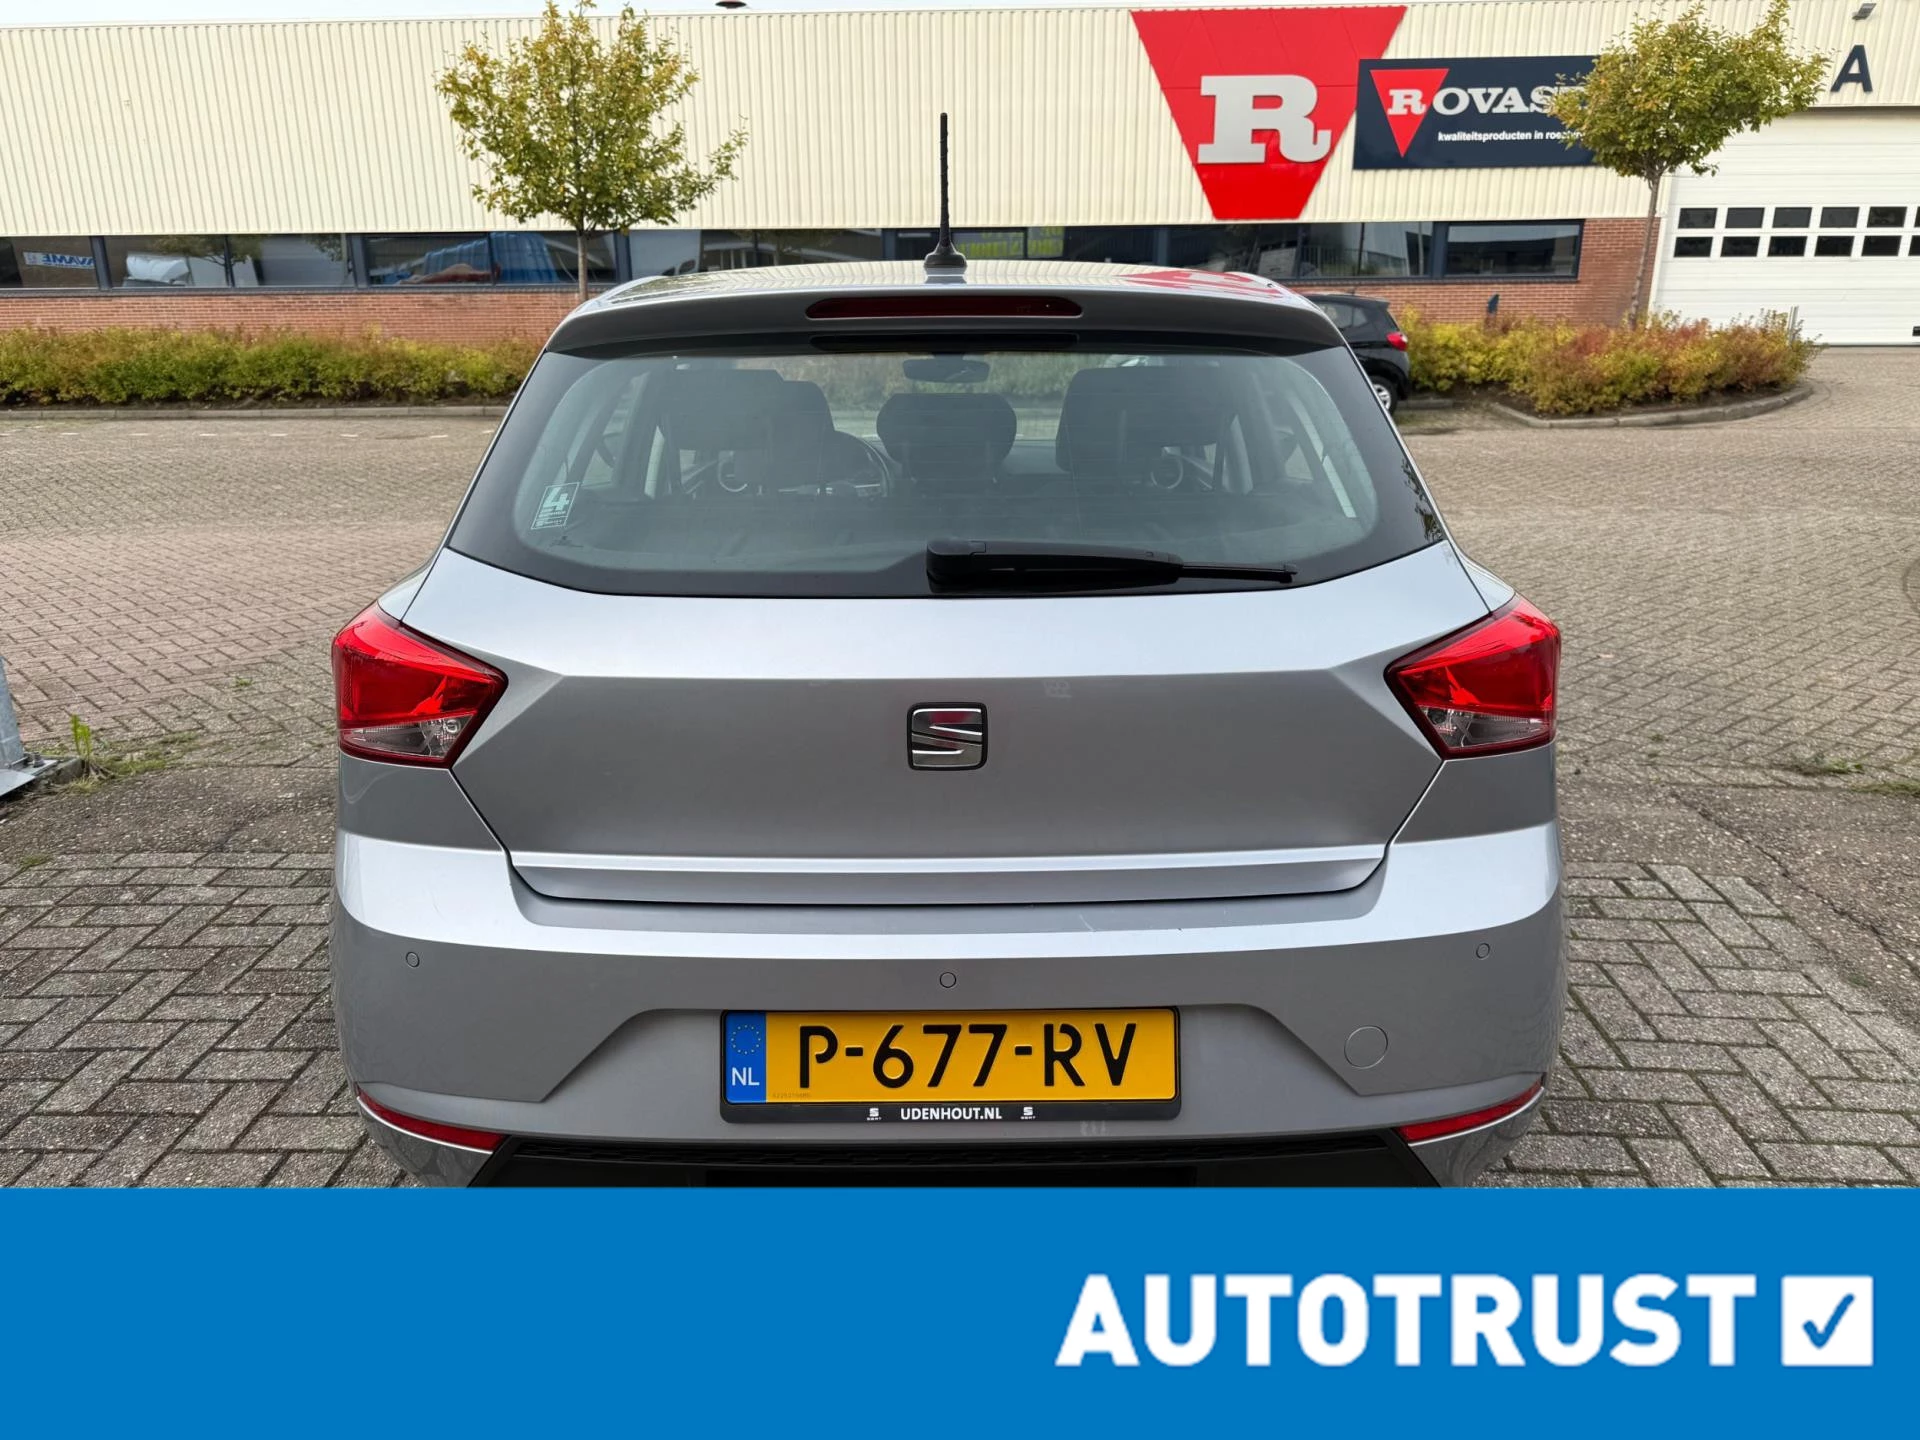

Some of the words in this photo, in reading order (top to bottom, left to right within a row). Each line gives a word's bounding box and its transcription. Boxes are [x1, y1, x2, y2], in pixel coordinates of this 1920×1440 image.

[1830, 44, 1873, 92] A
[1197, 74, 1332, 163] R
[1438, 131, 1532, 143] kwaliteitsproducten
[1534, 130, 1543, 140] in
[799, 1022, 1137, 1089] P-677-RV
[731, 1066, 760, 1087] NL
[900, 1107, 1003, 1120] UDENHOUT.NL
